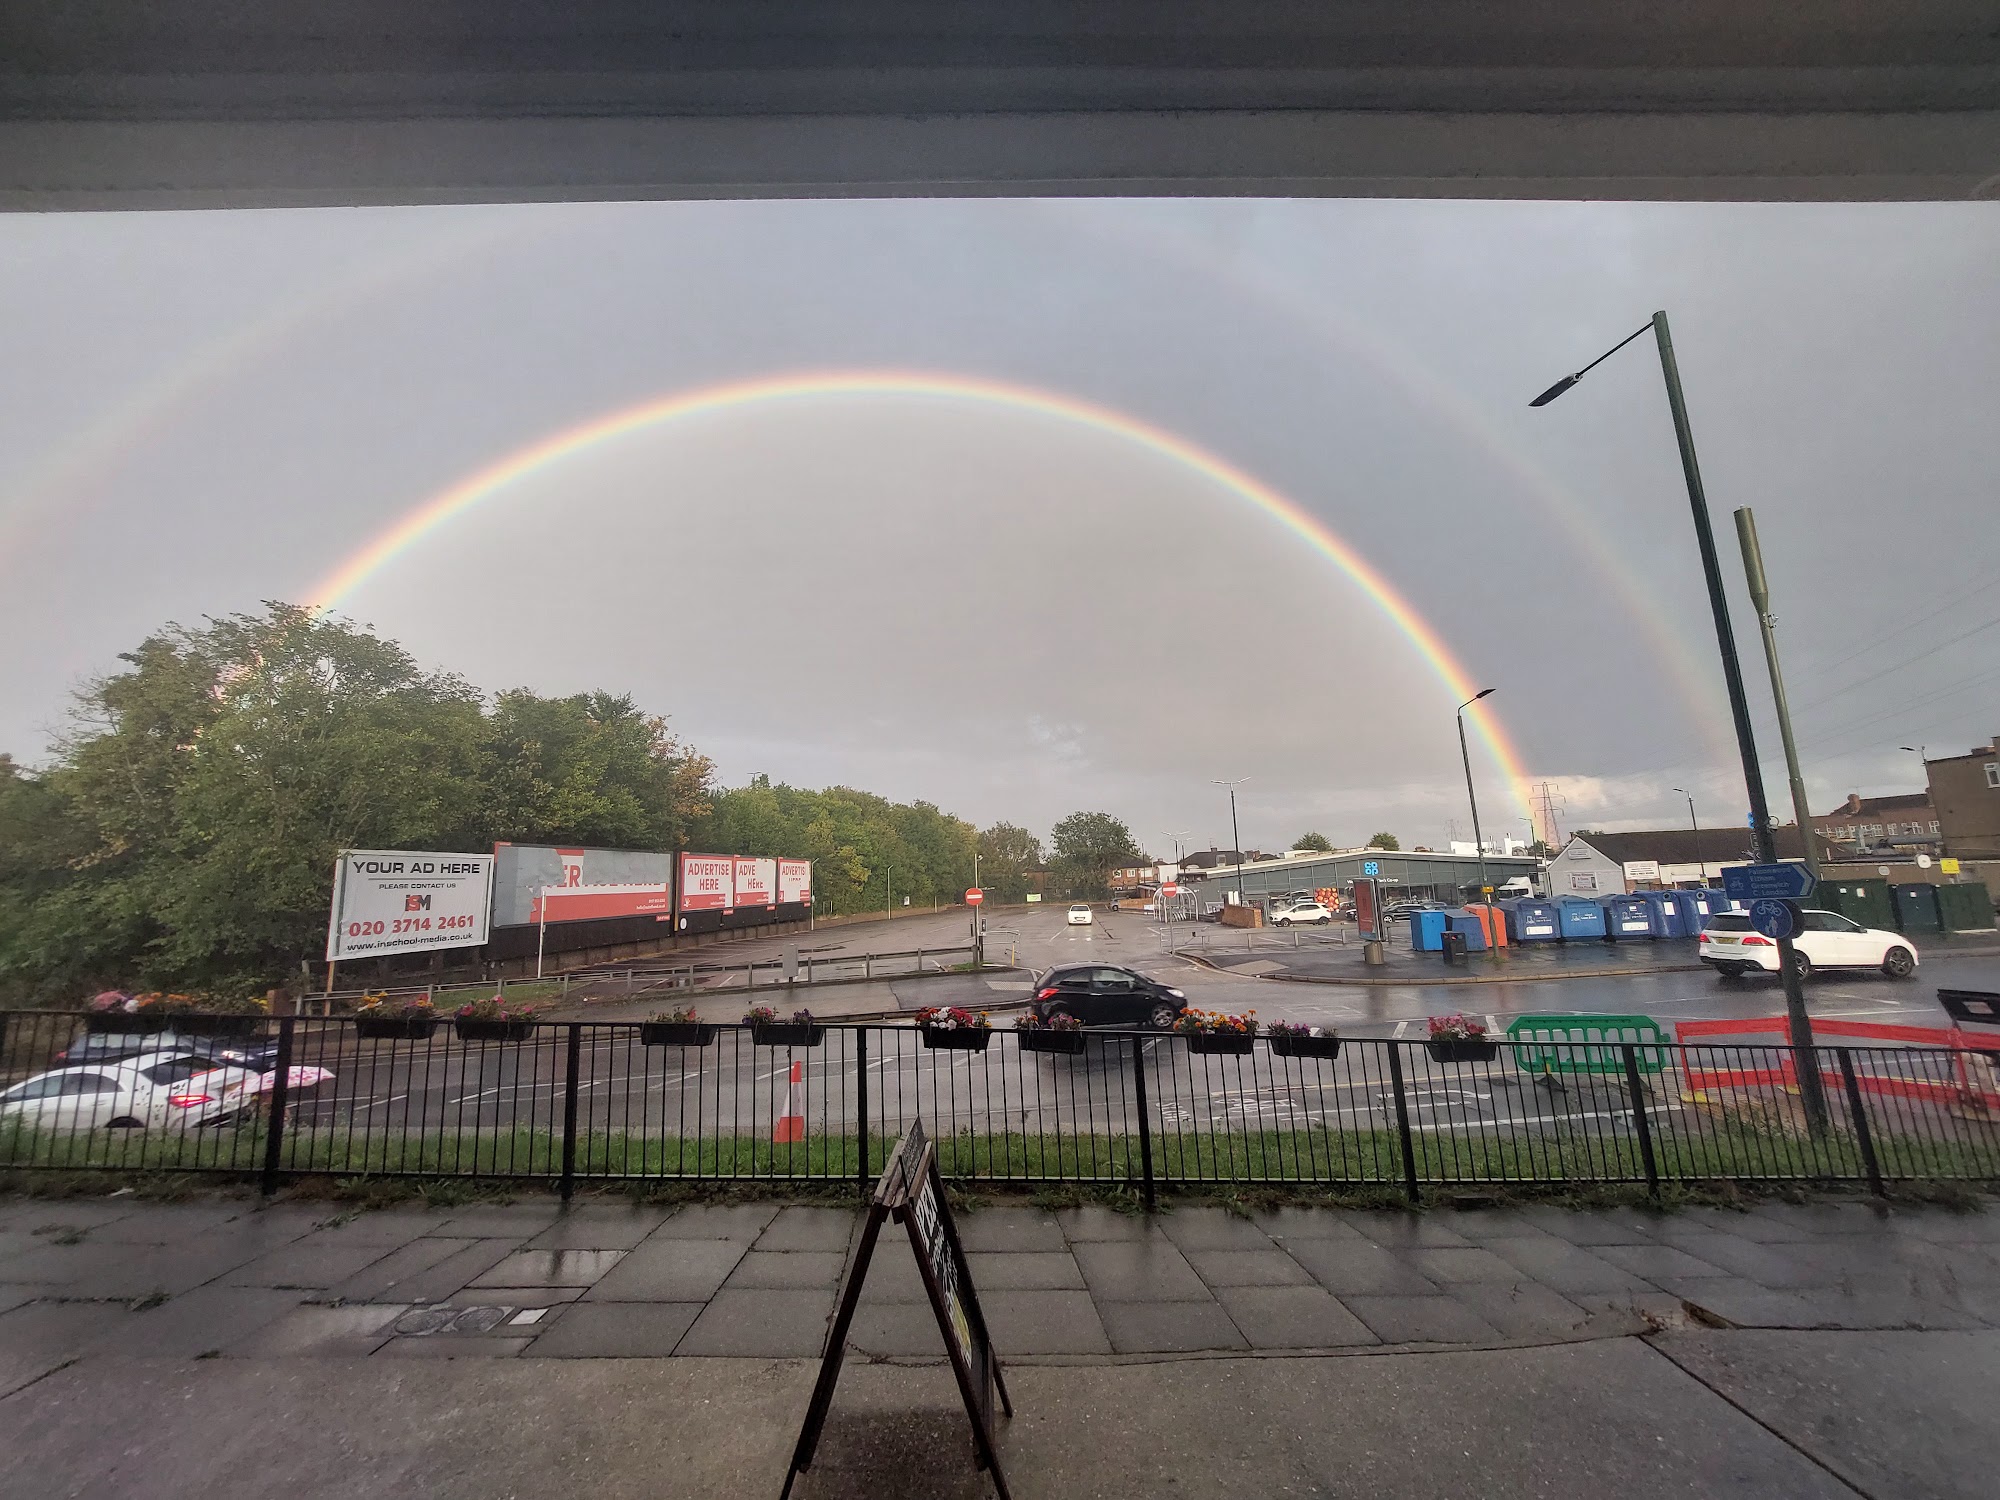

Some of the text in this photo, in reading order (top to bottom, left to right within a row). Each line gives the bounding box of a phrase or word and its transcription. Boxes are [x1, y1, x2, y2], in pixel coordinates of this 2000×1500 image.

[353, 862, 480, 874] YOUR AD HERE
[688, 862, 730, 876] ADVERTISE
[700, 878, 719, 891] HERE
[348, 915, 474, 937] 020 3714 2461
[347, 933, 473, 951] www.inschool-media.co.uk
